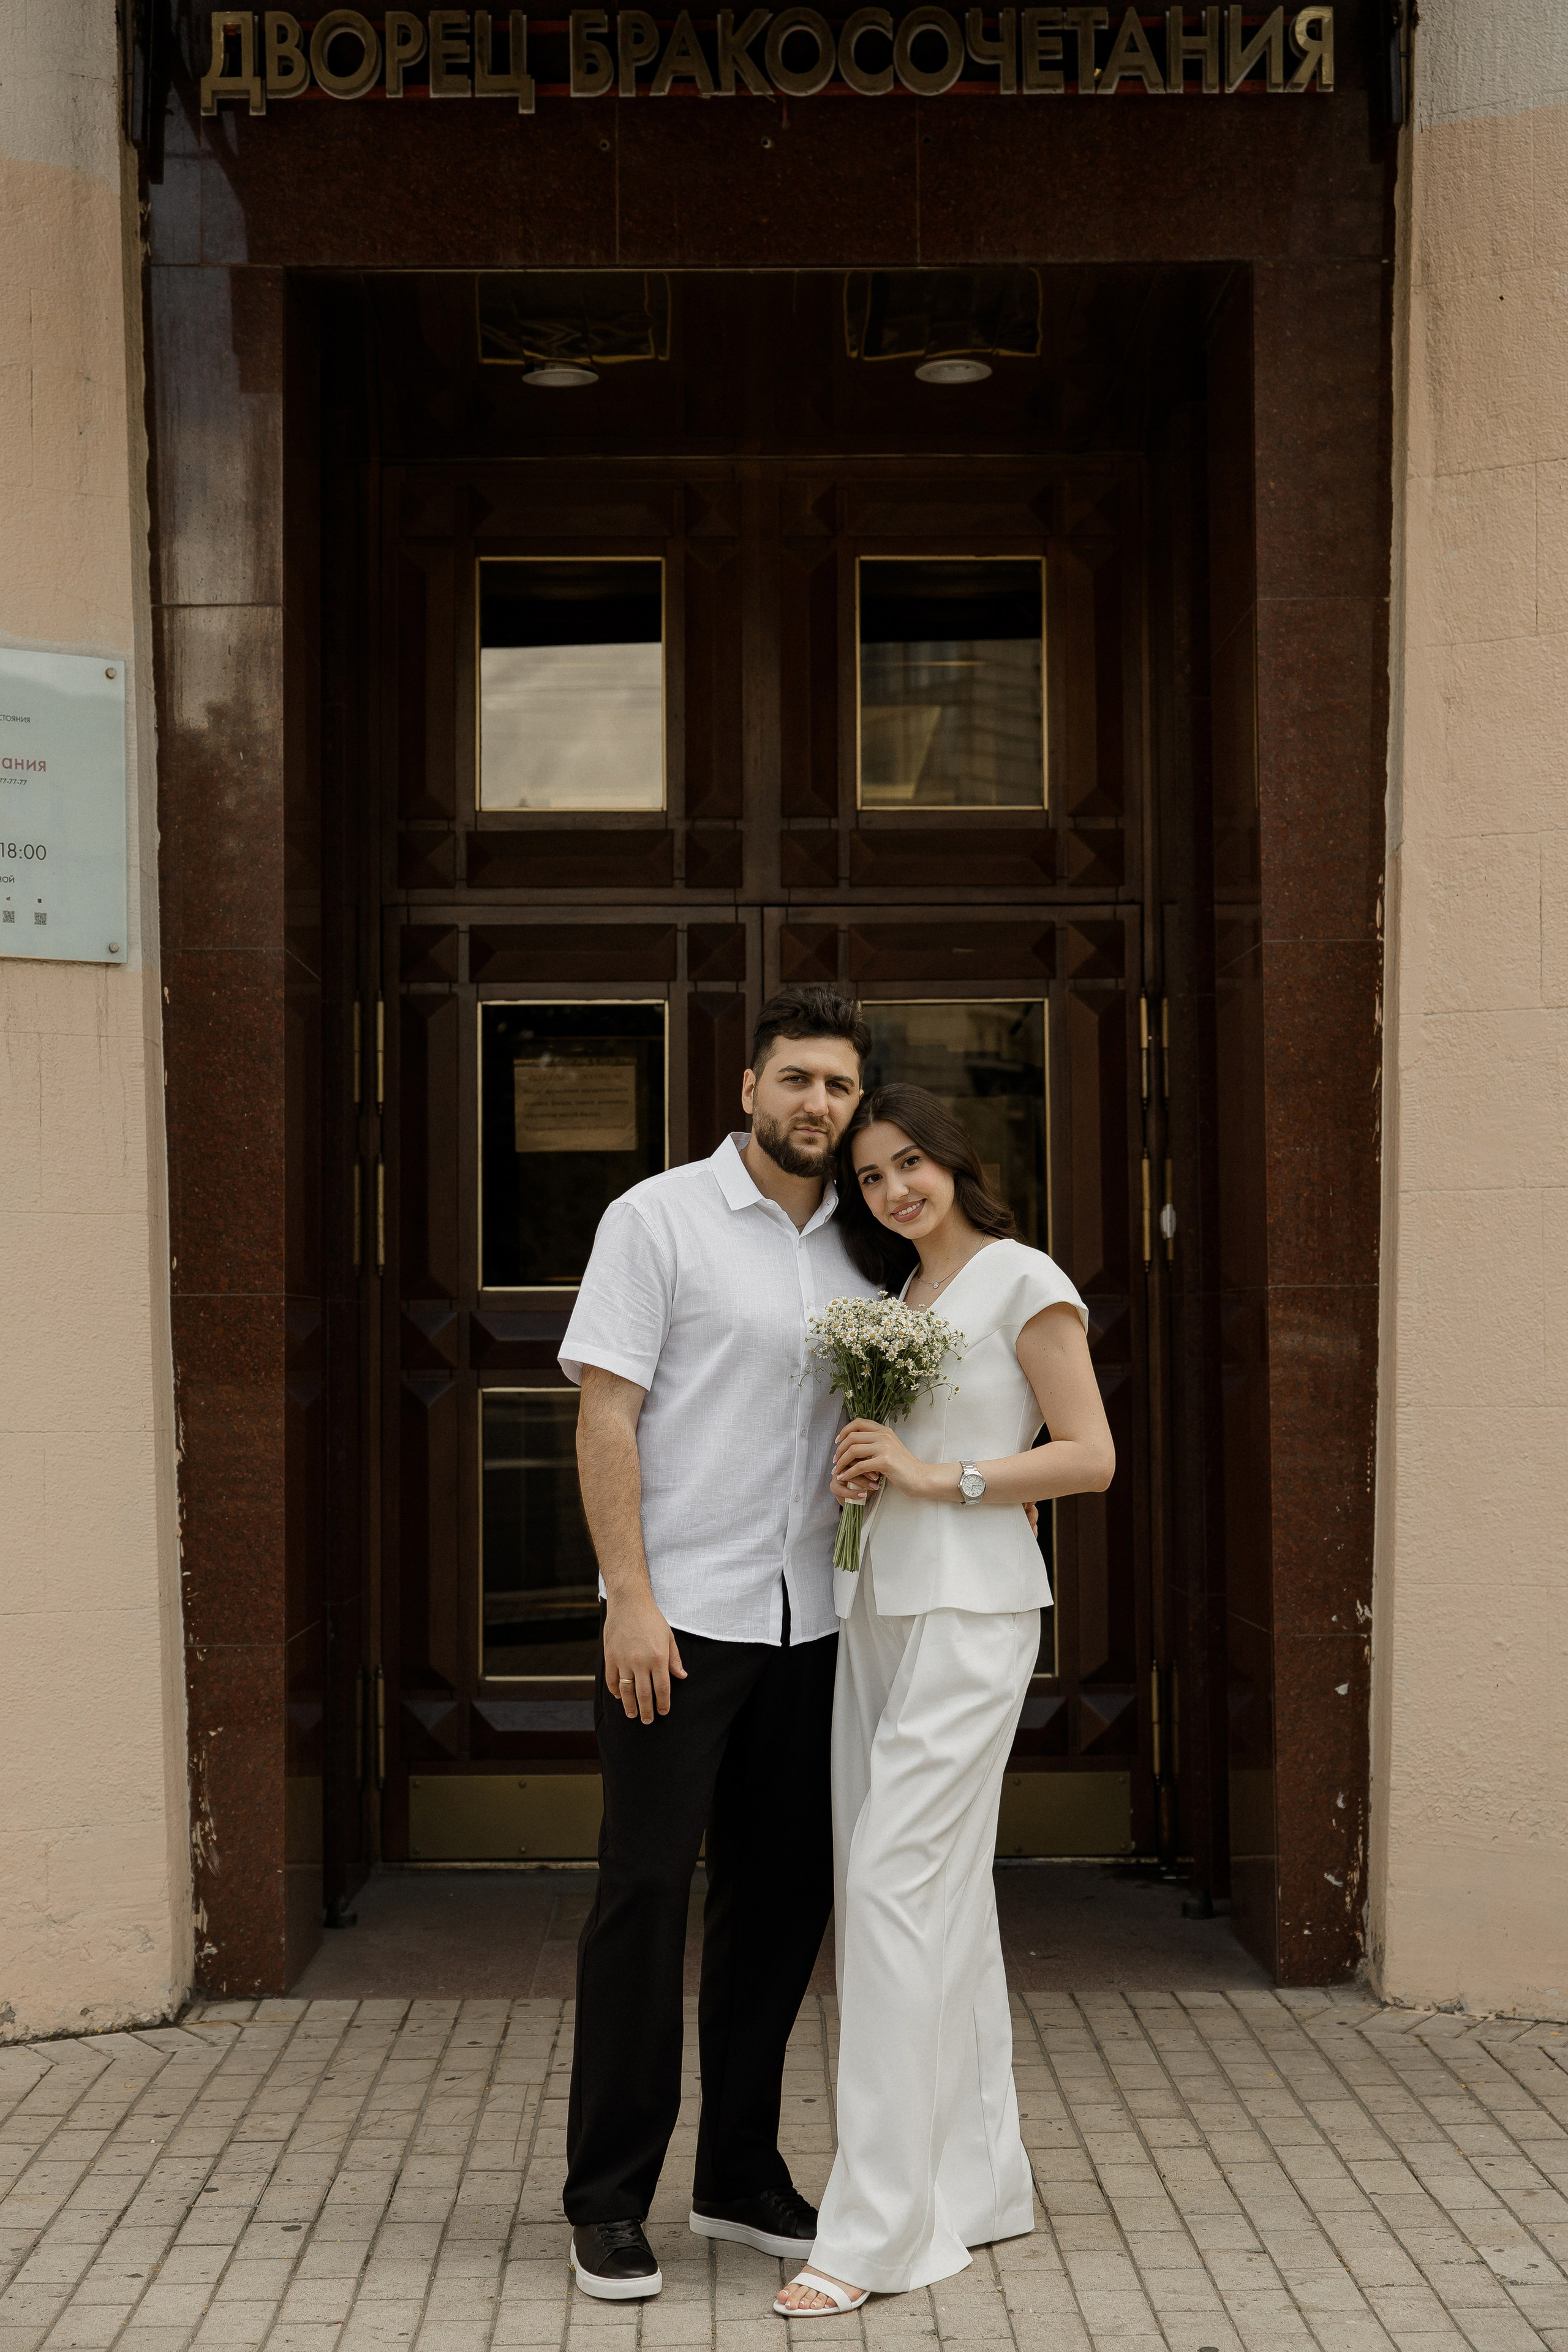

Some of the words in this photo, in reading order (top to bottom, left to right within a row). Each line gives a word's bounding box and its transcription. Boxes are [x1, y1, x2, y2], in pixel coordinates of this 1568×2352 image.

[201, 9, 535, 116] ДВОРЕЦ
[570, 6, 1334, 98] БРАКОСОЧЕТАНИЯ
[0, 842, 47, 861] 18:00
